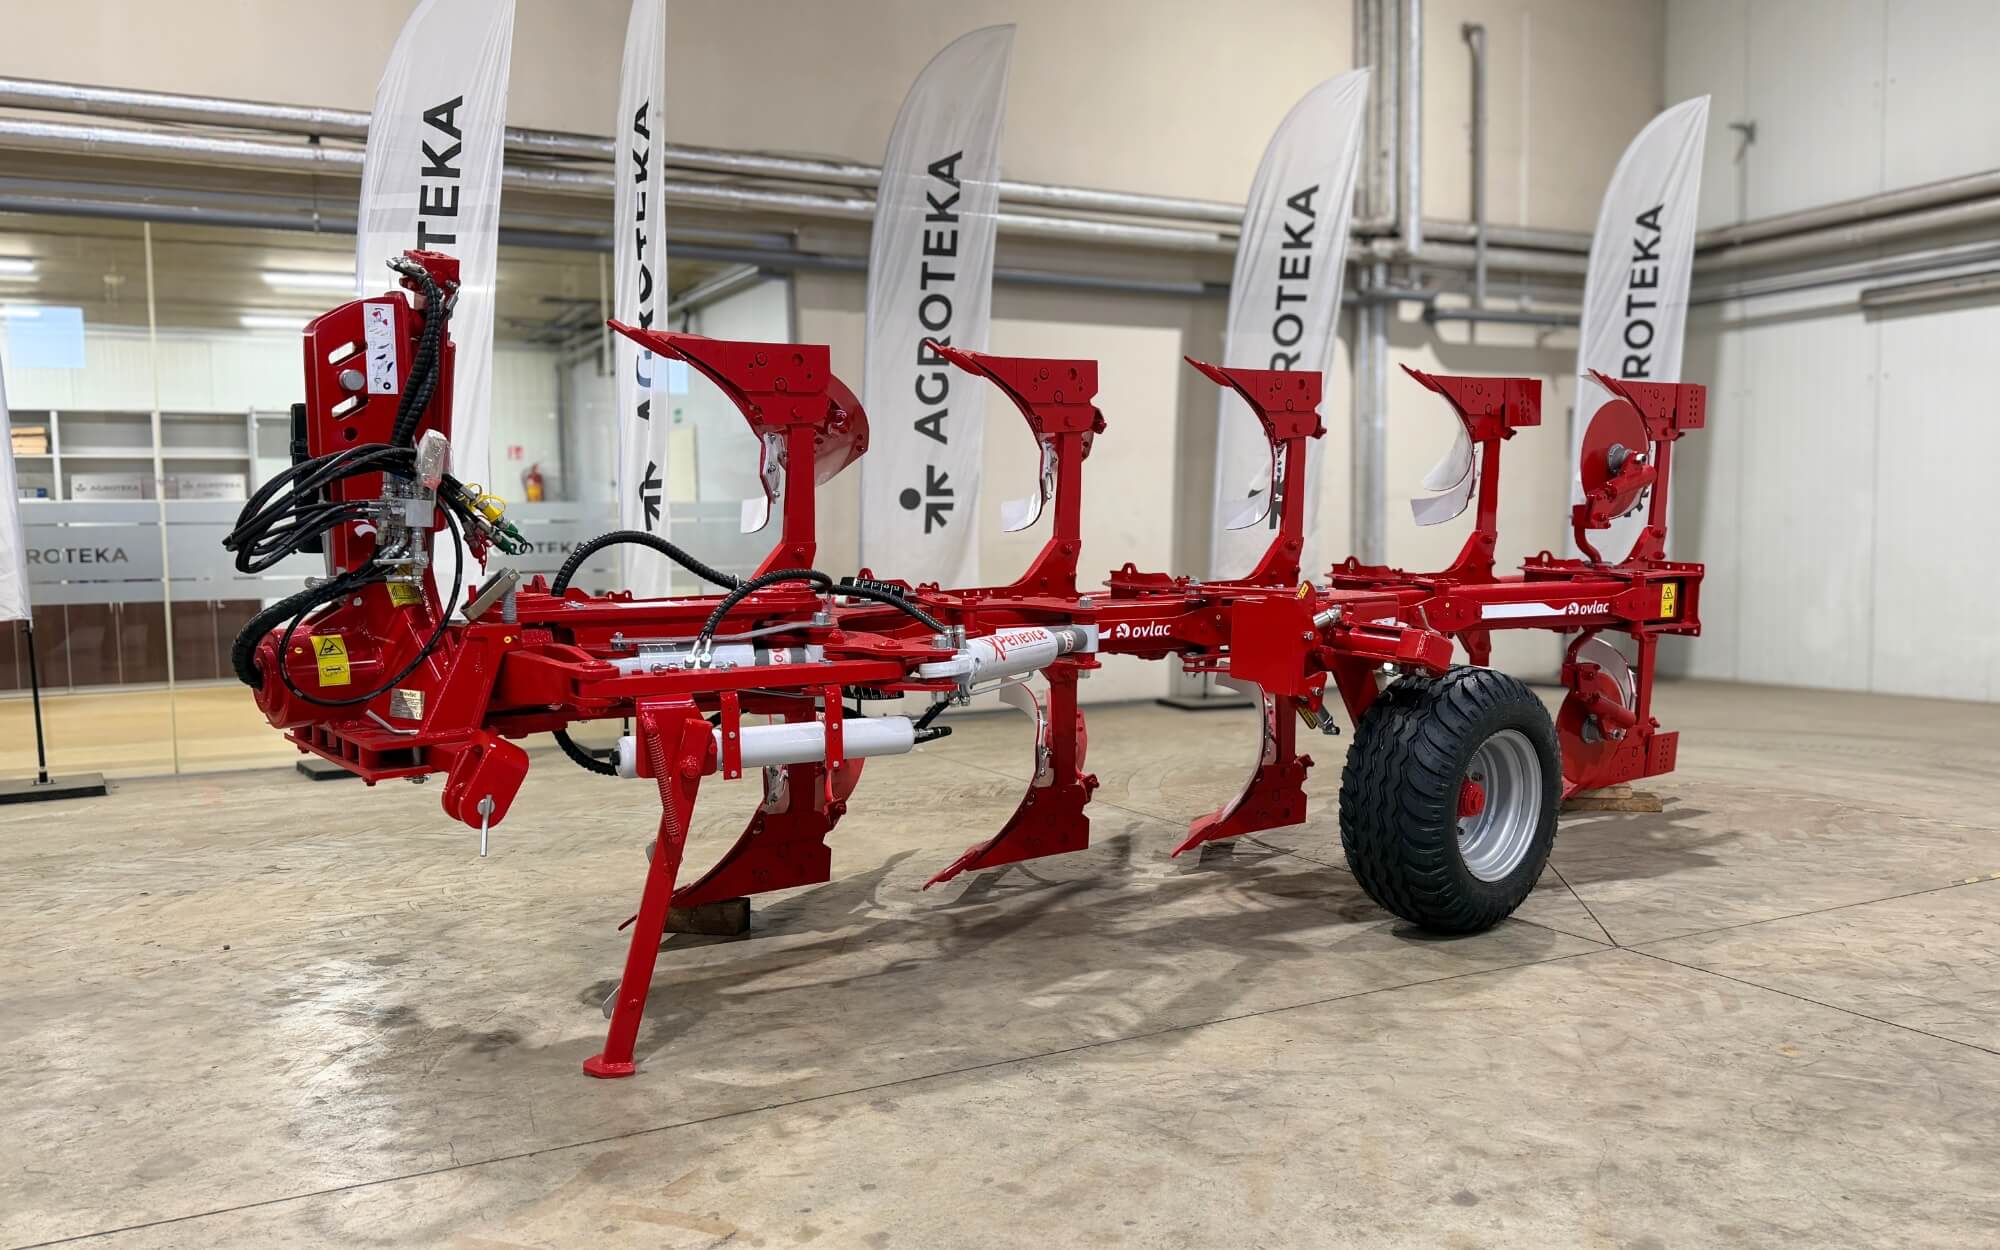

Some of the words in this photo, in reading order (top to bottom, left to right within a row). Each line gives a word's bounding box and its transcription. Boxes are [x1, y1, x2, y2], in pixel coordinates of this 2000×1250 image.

[914, 151, 963, 445] AGROTEKA
[1622, 204, 1664, 378] ROTEKA
[25, 547, 128, 564] ROTEKA
[1580, 600, 1610, 615] ovlac
[1132, 621, 1172, 638] ovlac
